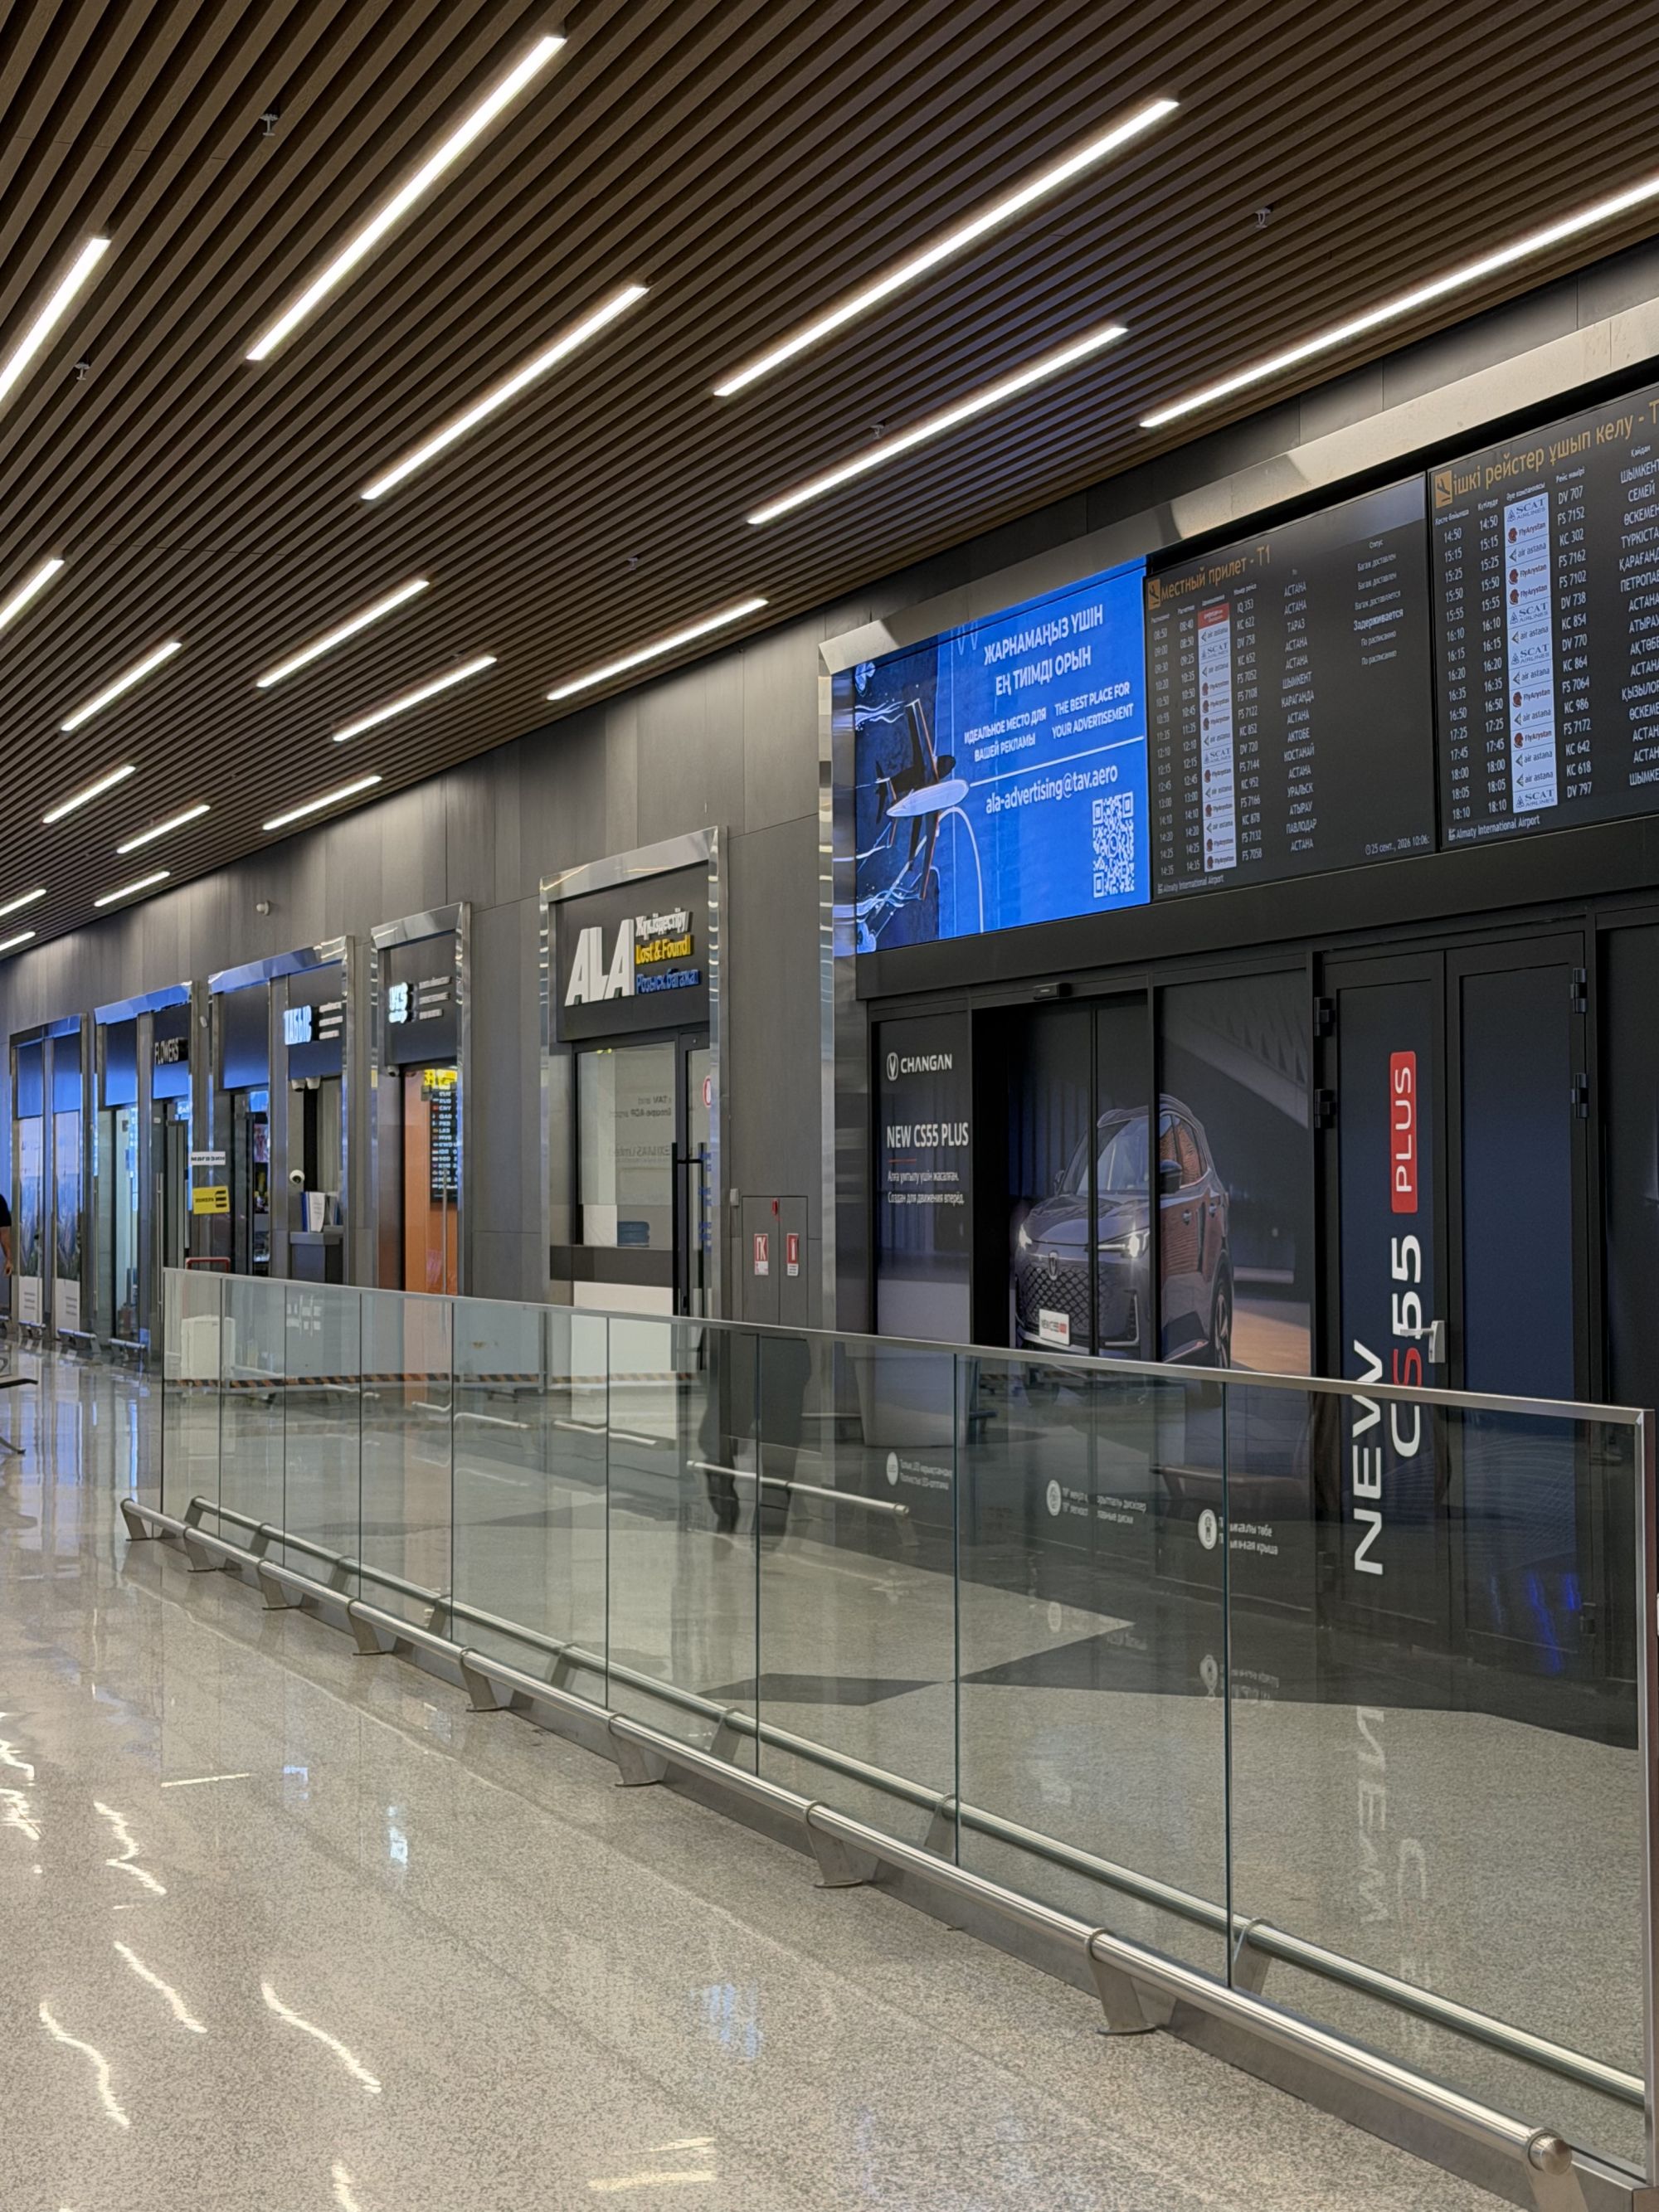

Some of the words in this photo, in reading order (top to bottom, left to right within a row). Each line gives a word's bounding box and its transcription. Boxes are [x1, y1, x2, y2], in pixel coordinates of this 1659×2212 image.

[1453, 465, 1481, 496] ішкі
[1486, 449, 1545, 489] рейстер
[1550, 431, 1591, 466] ұшып
[1596, 415, 1634, 445] келу
[1558, 490, 1569, 504] DV
[1570, 485, 1583, 502] 707
[1628, 479, 1656, 503] СЕМЕЙ
[1516, 498, 1545, 513] SCAT
[1480, 515, 1498, 531] 14:50
[1558, 512, 1566, 526] FS
[1568, 507, 1585, 522] 7152
[1444, 527, 1462, 542] 14:50
[1520, 522, 1546, 536] FlyArystan
[1571, 527, 1584, 544] 302
[1481, 535, 1499, 551] 15:15
[1527, 542, 1546, 554] astana
[1445, 547, 1462, 562] 15:15
[1559, 554, 1567, 568] FS
[1569, 549, 1586, 564] 7162
[1481, 556, 1499, 571] 15:25
[1520, 563, 1547, 577] FlyArystan
[1161, 566, 1205, 601] местный
[1209, 557, 1247, 587] прилет
[1446, 567, 1462, 582] 15:25
[1559, 575, 1568, 589] FS
[1569, 571, 1587, 585] 7102
[1481, 576, 1500, 591] 15:50
[1521, 584, 1548, 598] FlyArystan
[1446, 587, 1463, 602] 15:50
[1561, 596, 1572, 610] DV
[1574, 591, 1586, 607] 738
[1482, 596, 1501, 611] 15:55
[1519, 602, 1548, 616] SCAT
[1447, 607, 1464, 622] 15:55
[1574, 612, 1587, 628] 854
[1287, 618, 1305, 633] ТАРАЗ
[1483, 616, 1501, 632] 16:10
[984, 618, 1070, 665] ЖАРНАМАҢЫЗ
[1073, 604, 1103, 634] ҮШІН
[1447, 627, 1465, 642] 16:10
[1285, 636, 1307, 652] АСТАНА
[1483, 637, 1501, 652] 16:15
[1520, 644, 1550, 657] SCAT
[1563, 638, 1573, 652] DV
[1574, 634, 1588, 649] 770
[1448, 647, 1465, 662] 16:15
[1484, 657, 1502, 672] 16:20
[1575, 655, 1588, 670] 864
[995, 673, 1012, 698] ЕҢ
[1014, 658, 1053, 693] ТИІМДІ
[1055, 645, 1091, 676] ОРЫН
[1448, 667, 1466, 682] 16:20
[1485, 677, 1503, 693] 16:35
[1563, 680, 1571, 693] FS
[1573, 676, 1590, 690] 7064
[1054, 699, 1069, 717] THE
[1071, 694, 1091, 713] BEST
[1092, 688, 1113, 709] PLACE
[1115, 682, 1130, 700] FOR
[1282, 689, 1314, 708] КАРАГАНДА
[1449, 687, 1467, 701] 16:35
[1524, 688, 1550, 701] FlyArystan
[1485, 698, 1503, 712] 16:50
[1576, 698, 1589, 712] 986
[1051, 719, 1072, 739] YOUR
[1073, 702, 1134, 734] ADVERTISEMENT
[1287, 709, 1310, 725] АСТАНА
[1450, 707, 1467, 721] 16:50
[964, 722, 1005, 746] ИДЕАЛЬНОЕ
[1005, 714, 1030, 734] МЕСТО
[1032, 707, 1046, 725] ДЛЯ
[1486, 717, 1504, 733] 17:25
[1564, 722, 1572, 736] FS
[1574, 718, 1591, 732] 7172
[1287, 727, 1311, 743] АКТОБЕ
[1451, 727, 1467, 741] 17:25
[1525, 730, 1551, 742] FlyArystan
[974, 739, 1000, 762] ВАШЕЙ
[1001, 732, 1036, 756] РЕКЛАМЫ
[1284, 742, 1315, 762] КОСТАНАЙ
[1486, 738, 1505, 753] 17:45
[1578, 740, 1590, 754] 642
[1452, 746, 1468, 761] 17:45
[1534, 751, 1553, 761] astana
[1288, 765, 1311, 780] АСТАНА
[1452, 766, 1469, 780] 18:00
[1487, 758, 1506, 773] 18:00
[1578, 761, 1591, 775] 618
[1535, 771, 1553, 782] astana
[985, 764, 1118, 814] ala-advertising@tav.aero
[1287, 782, 1314, 798] УРАЛЬСК
[1452, 786, 1469, 800] 18:05
[1487, 779, 1506, 794] 18:05
[1567, 785, 1577, 799] DV
[1579, 782, 1591, 796] 797
[1525, 790, 1554, 801] SCAT
[1289, 801, 1313, 815] АТЫРАУ
[1453, 806, 1470, 819] 18:10
[1488, 799, 1506, 814] 18:10
[1287, 819, 1317, 834] ПАВЛОДАР
[1456, 828, 1477, 839] Almaty
[1478, 819, 1516, 835] International
[1519, 814, 1540, 829] Airport
[1291, 838, 1314, 852] АСТАНА
[636, 942, 653, 965] Lost
[654, 939, 662, 960] &
[663, 934, 691, 960] Found
[565, 919, 635, 1007] ALA
[637, 974, 665, 994] Розыск
[667, 969, 700, 989] багажа
[154, 1038, 179, 1065] FLOWERS
[900, 1053, 952, 1073] CHANGAN
[887, 1125, 911, 1148] NEW
[914, 1123, 939, 1147] CS55
[941, 1122, 969, 1146] PLUS
[1394, 1066, 1414, 1194] PLUS
[1391, 1233, 1423, 1458] CS55
[1352, 1339, 1385, 1576] NEW
